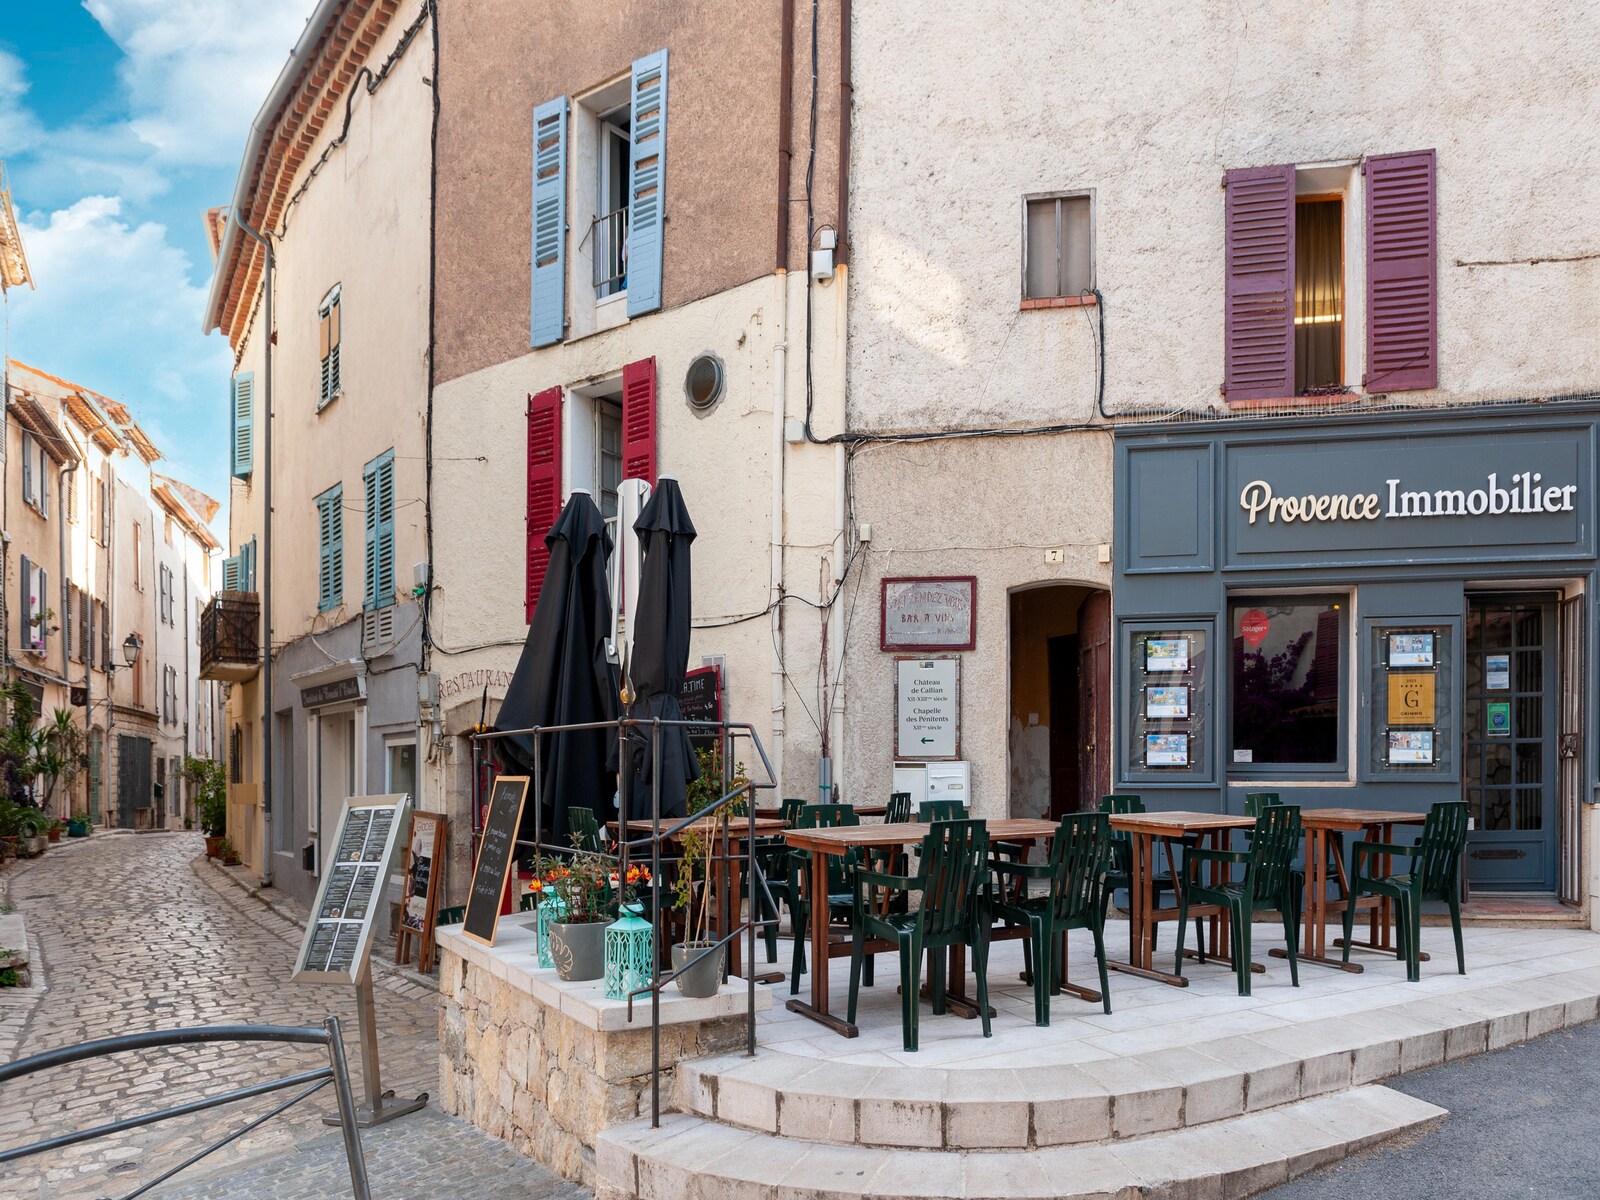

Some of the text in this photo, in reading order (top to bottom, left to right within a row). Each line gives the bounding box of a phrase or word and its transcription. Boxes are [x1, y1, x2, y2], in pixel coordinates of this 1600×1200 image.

[1240, 472, 1577, 524] Provence Immobilier
[1051, 551, 1058, 561] 7
[901, 613, 919, 623] BAR
[935, 612, 955, 623] VINS
[1404, 690, 1419, 708] G
